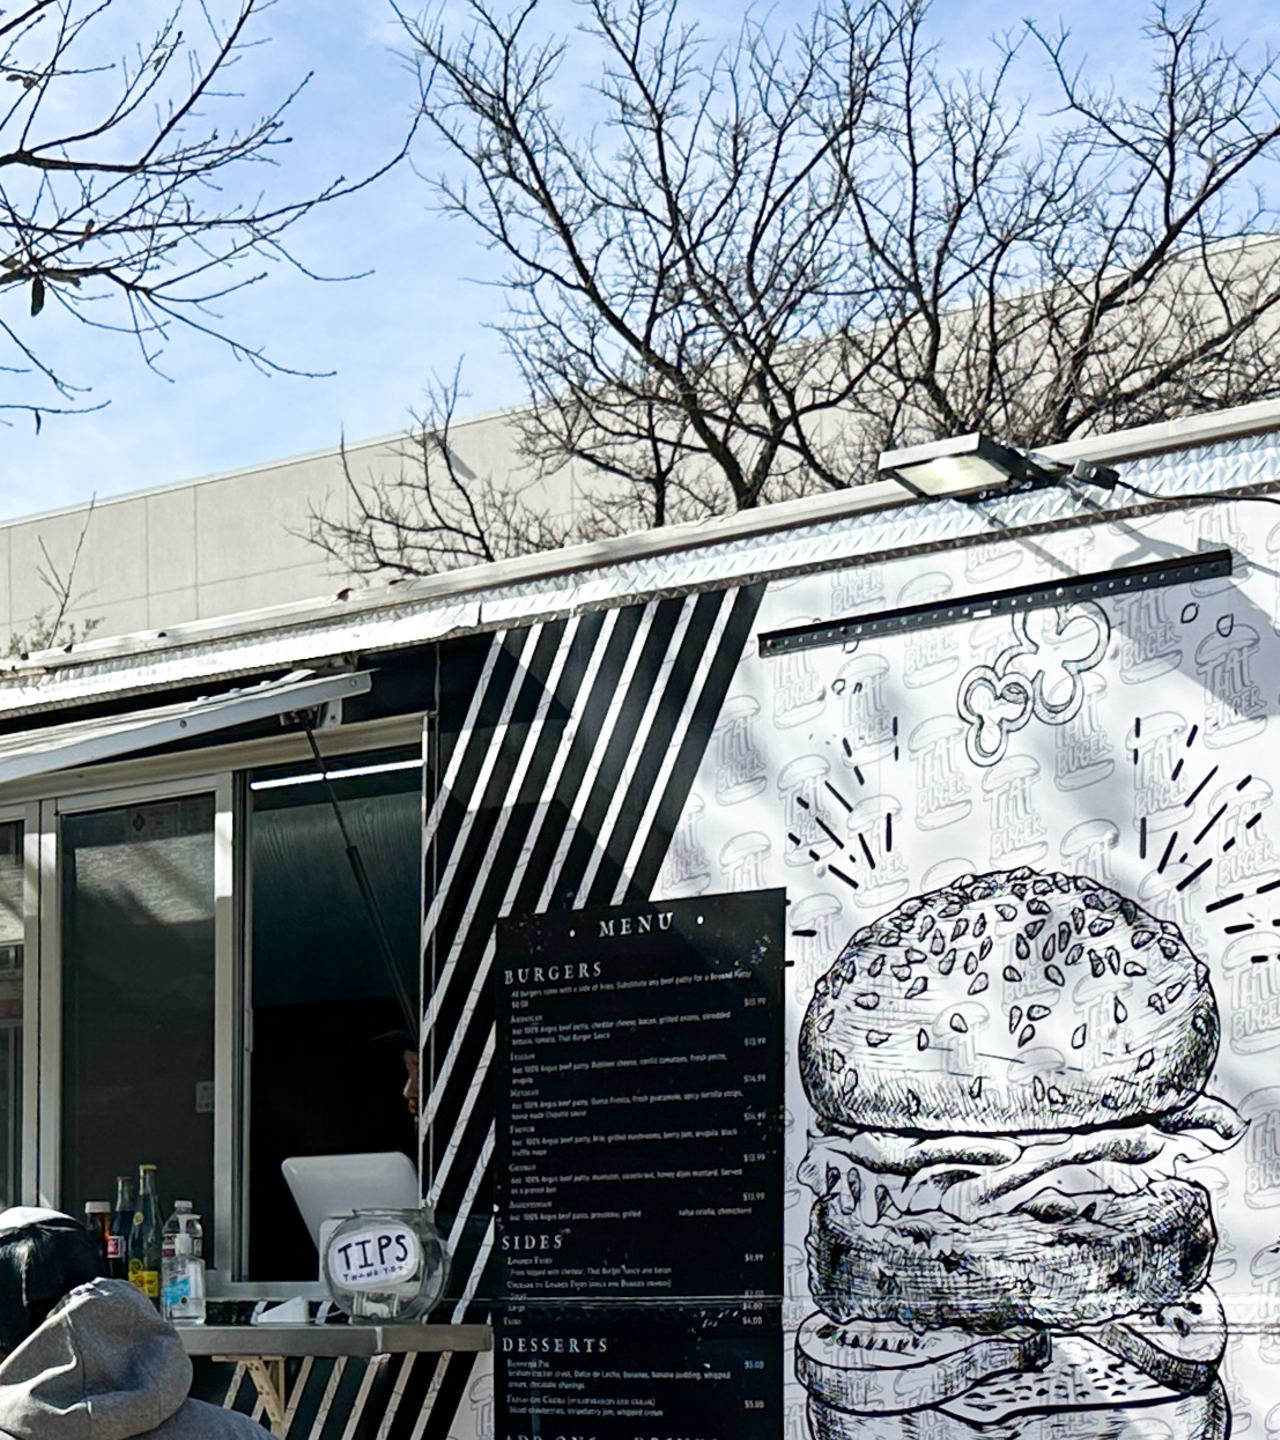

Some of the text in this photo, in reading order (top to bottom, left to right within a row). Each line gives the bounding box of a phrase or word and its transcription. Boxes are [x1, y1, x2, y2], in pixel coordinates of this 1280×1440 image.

[598, 912, 674, 938] MENU
[504, 962, 603, 985] BURGERS
[338, 1234, 408, 1271] TIPS
[502, 1234, 563, 1251] SIDES
[502, 1337, 608, 1353] DESSERTS
